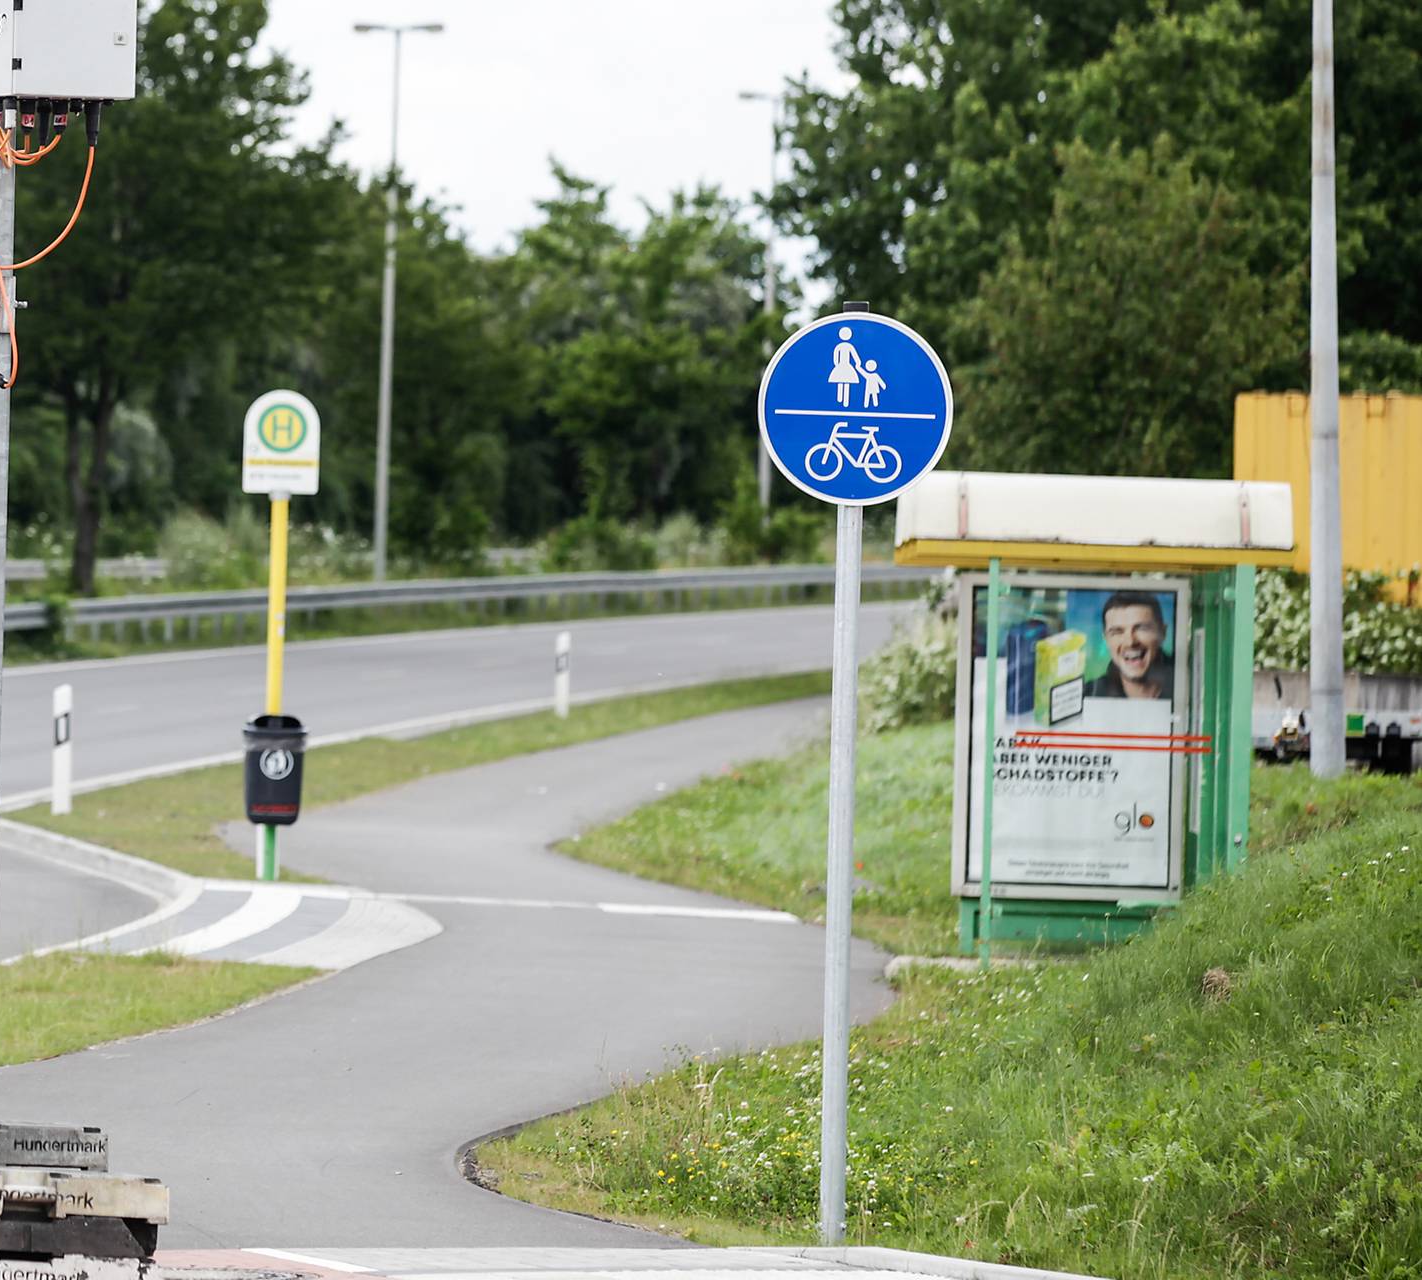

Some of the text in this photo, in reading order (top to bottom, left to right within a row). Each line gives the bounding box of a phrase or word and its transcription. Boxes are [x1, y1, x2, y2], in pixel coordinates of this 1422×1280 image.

[273, 415, 292, 441] H
[993, 752, 1113, 767] BER WENIGER
[1114, 802, 1154, 836] glo
